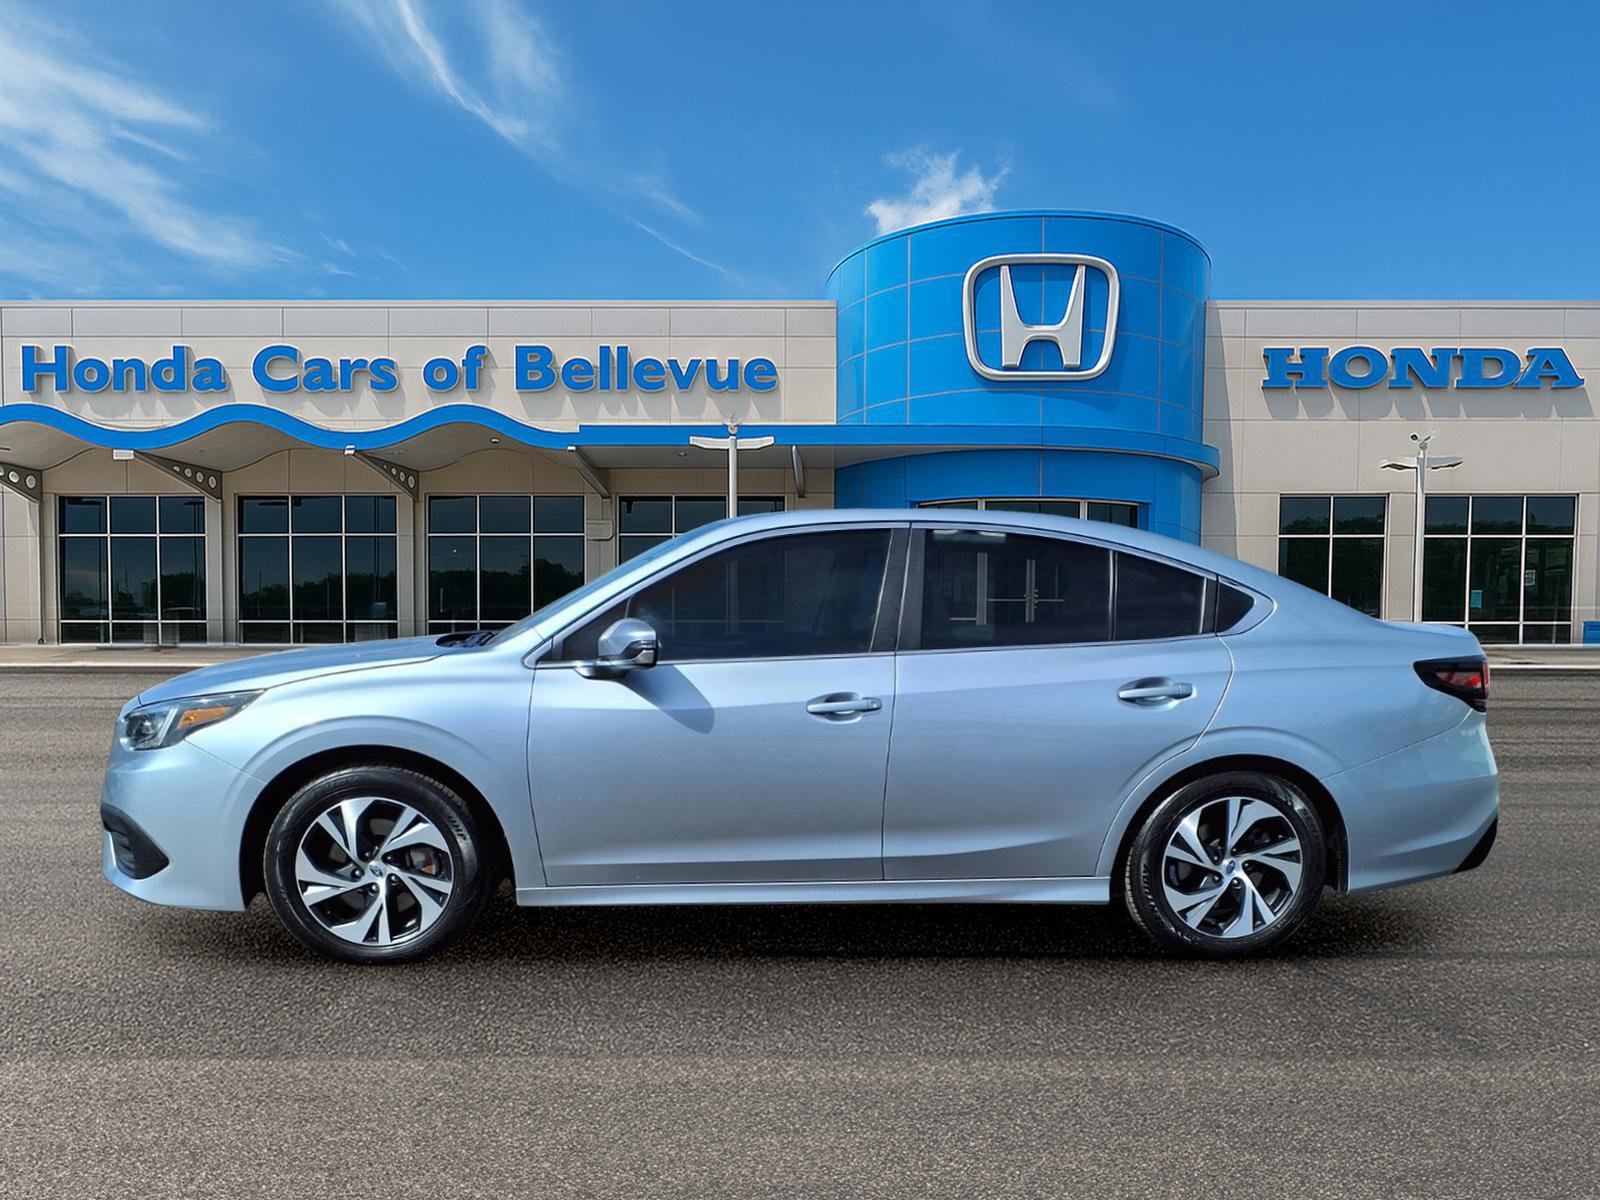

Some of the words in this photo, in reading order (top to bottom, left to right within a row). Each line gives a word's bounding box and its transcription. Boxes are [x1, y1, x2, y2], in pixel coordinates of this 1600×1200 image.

[21, 345, 228, 392] Honda
[252, 345, 398, 392] Cars
[423, 345, 486, 391] of
[515, 345, 778, 392] Bellevue
[1262, 345, 1586, 390] HONDA
